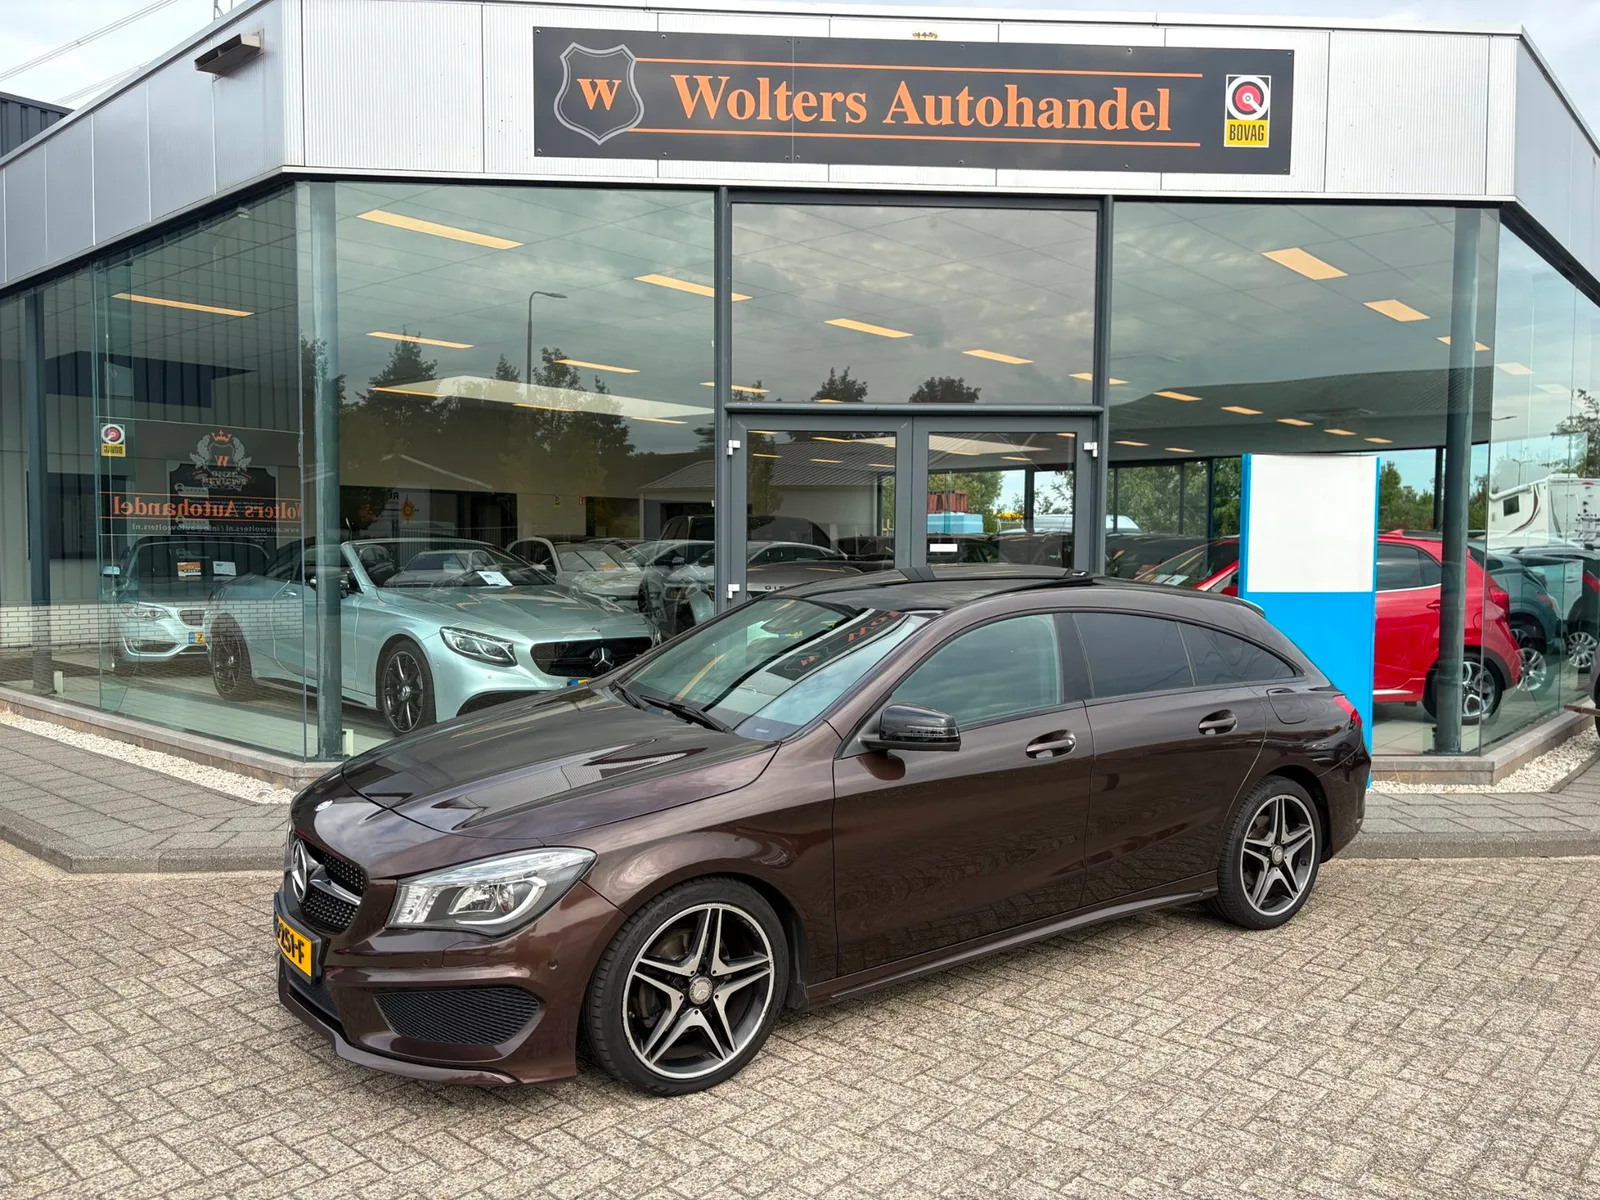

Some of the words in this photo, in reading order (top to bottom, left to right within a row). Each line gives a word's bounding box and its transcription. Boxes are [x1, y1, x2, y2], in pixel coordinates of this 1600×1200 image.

[577, 78, 622, 111] W
[671, 74, 868, 124] Wolters
[882, 80, 1172, 132] Autohandel
[1229, 124, 1265, 142] BOVAG
